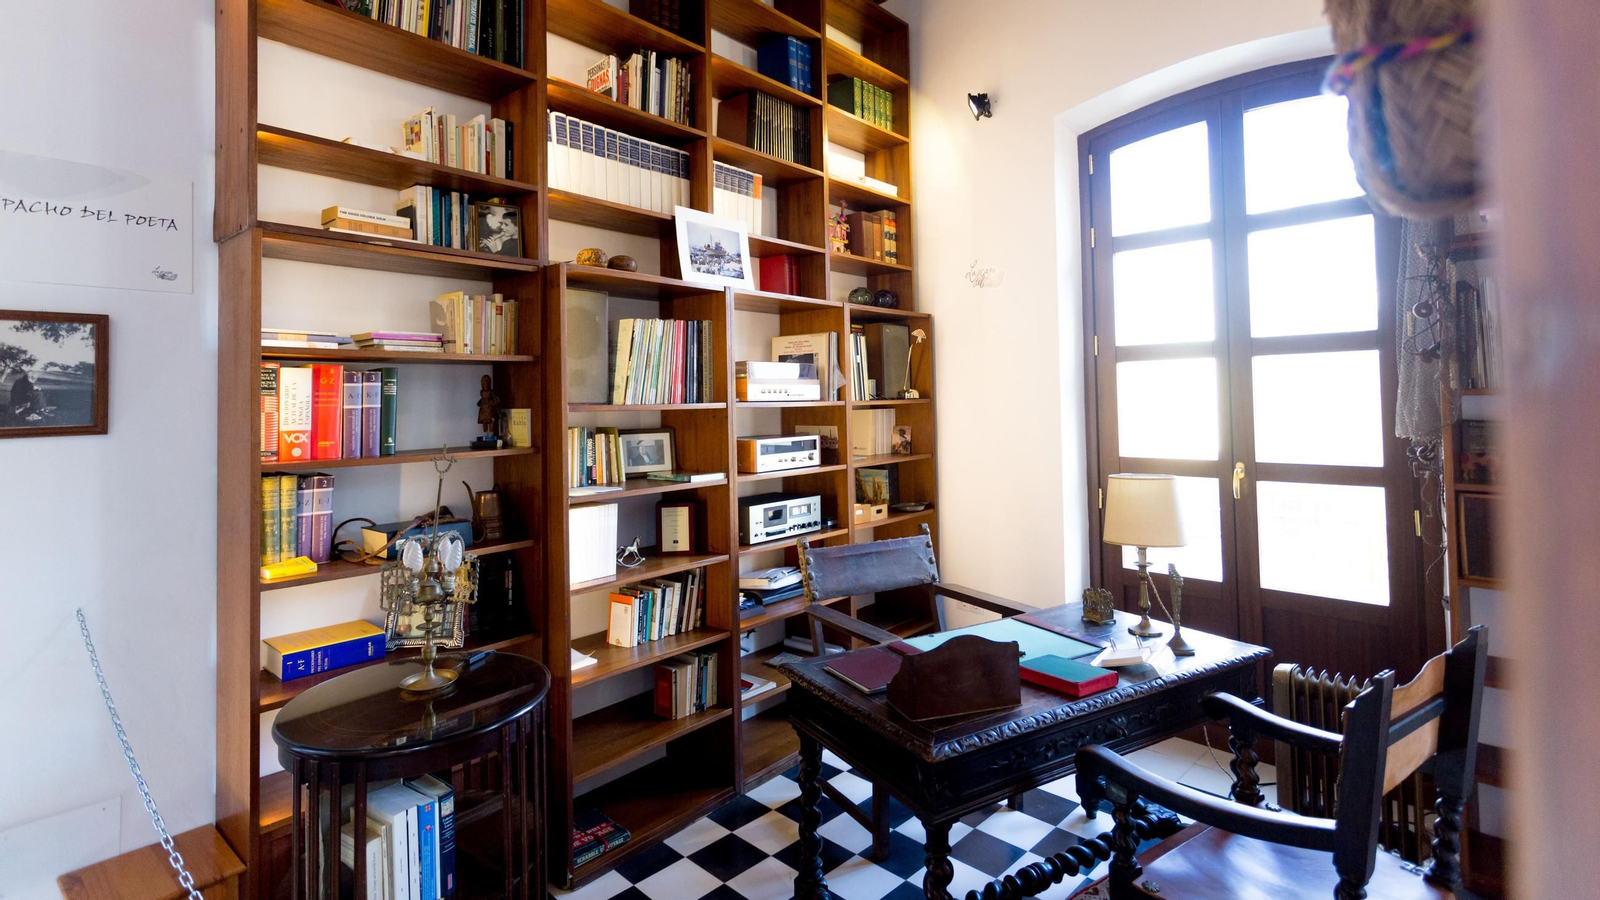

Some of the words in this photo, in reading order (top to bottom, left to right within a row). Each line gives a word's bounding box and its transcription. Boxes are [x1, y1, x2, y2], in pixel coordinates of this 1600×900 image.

[80, 205, 118, 222] DEL
[124, 213, 178, 231] POETA
[283, 433, 309, 444] VOX
